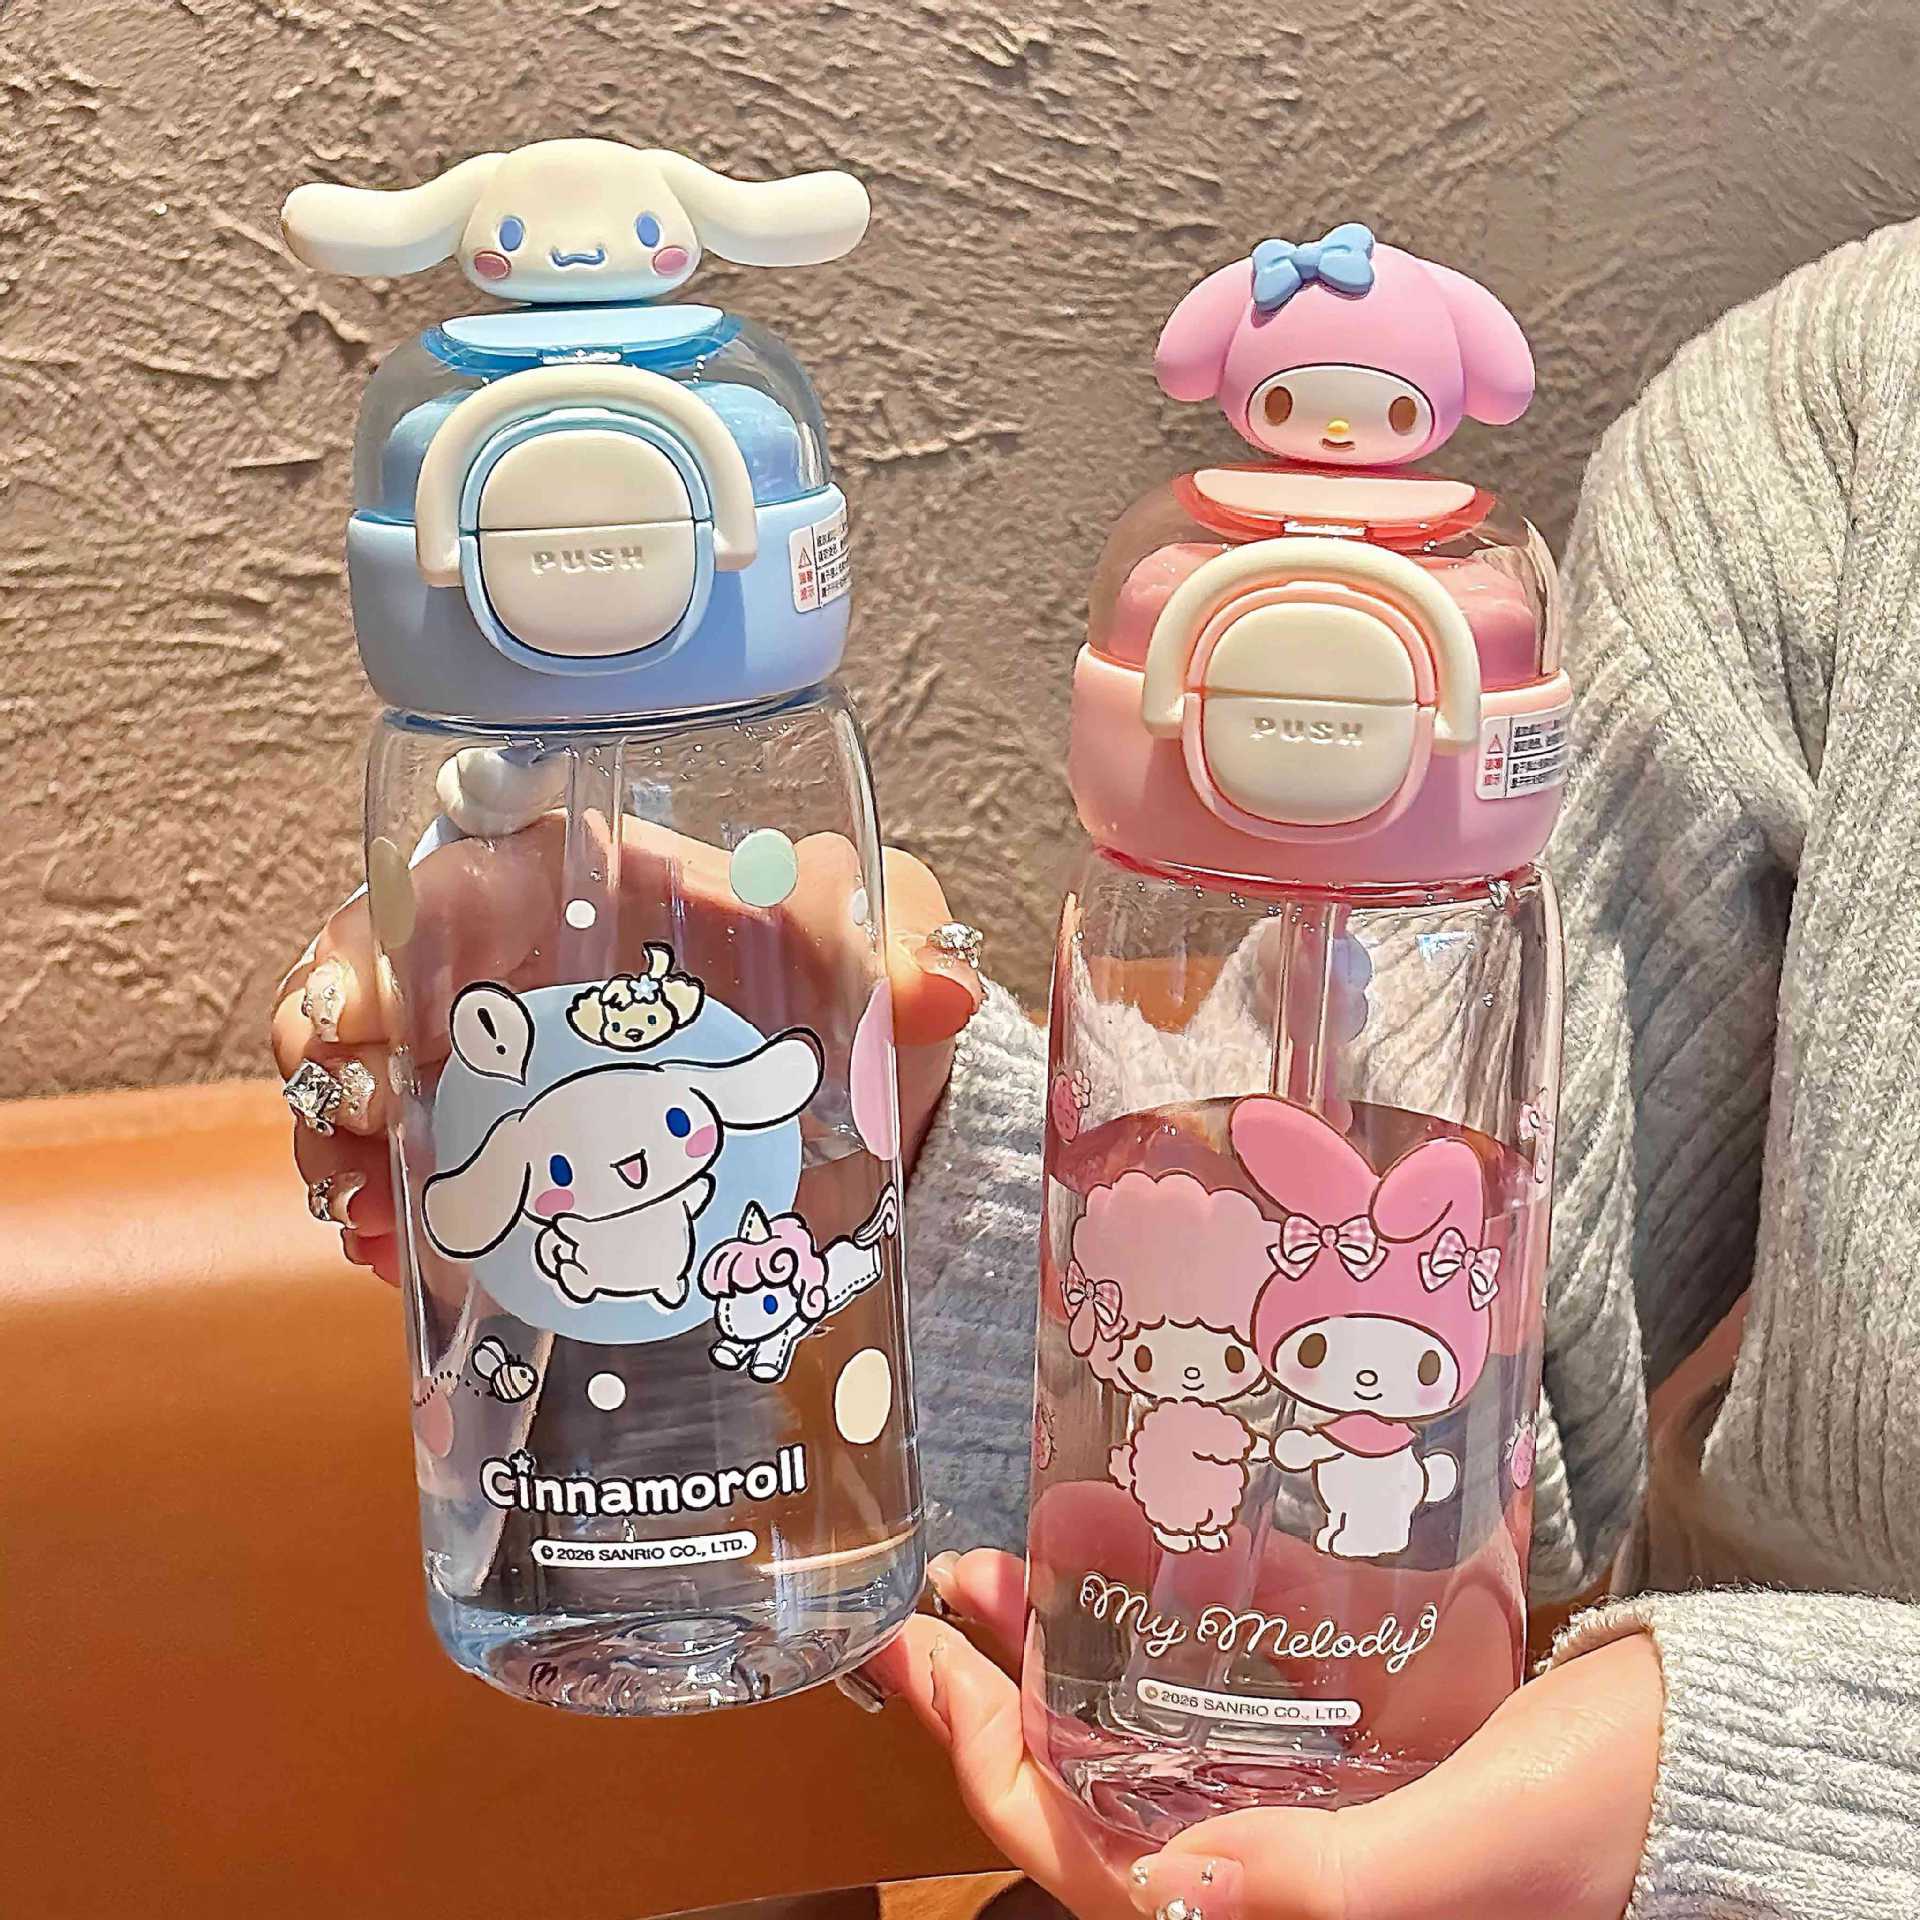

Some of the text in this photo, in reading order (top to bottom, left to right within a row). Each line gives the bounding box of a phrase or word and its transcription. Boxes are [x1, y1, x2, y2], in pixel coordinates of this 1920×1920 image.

[531, 547, 643, 575] PUSH
[1250, 717, 1362, 746] PUSH
[480, 1444, 807, 1516] Cinnamoroll
[557, 1548, 595, 1561] 2026
[599, 1547, 665, 1561] SANRIO
[711, 1539, 748, 1553] LTD.
[1080, 1573, 1438, 1674] My Melody
[1161, 1690, 1199, 1708] 2026
[1203, 1698, 1269, 1718] SANRIO
